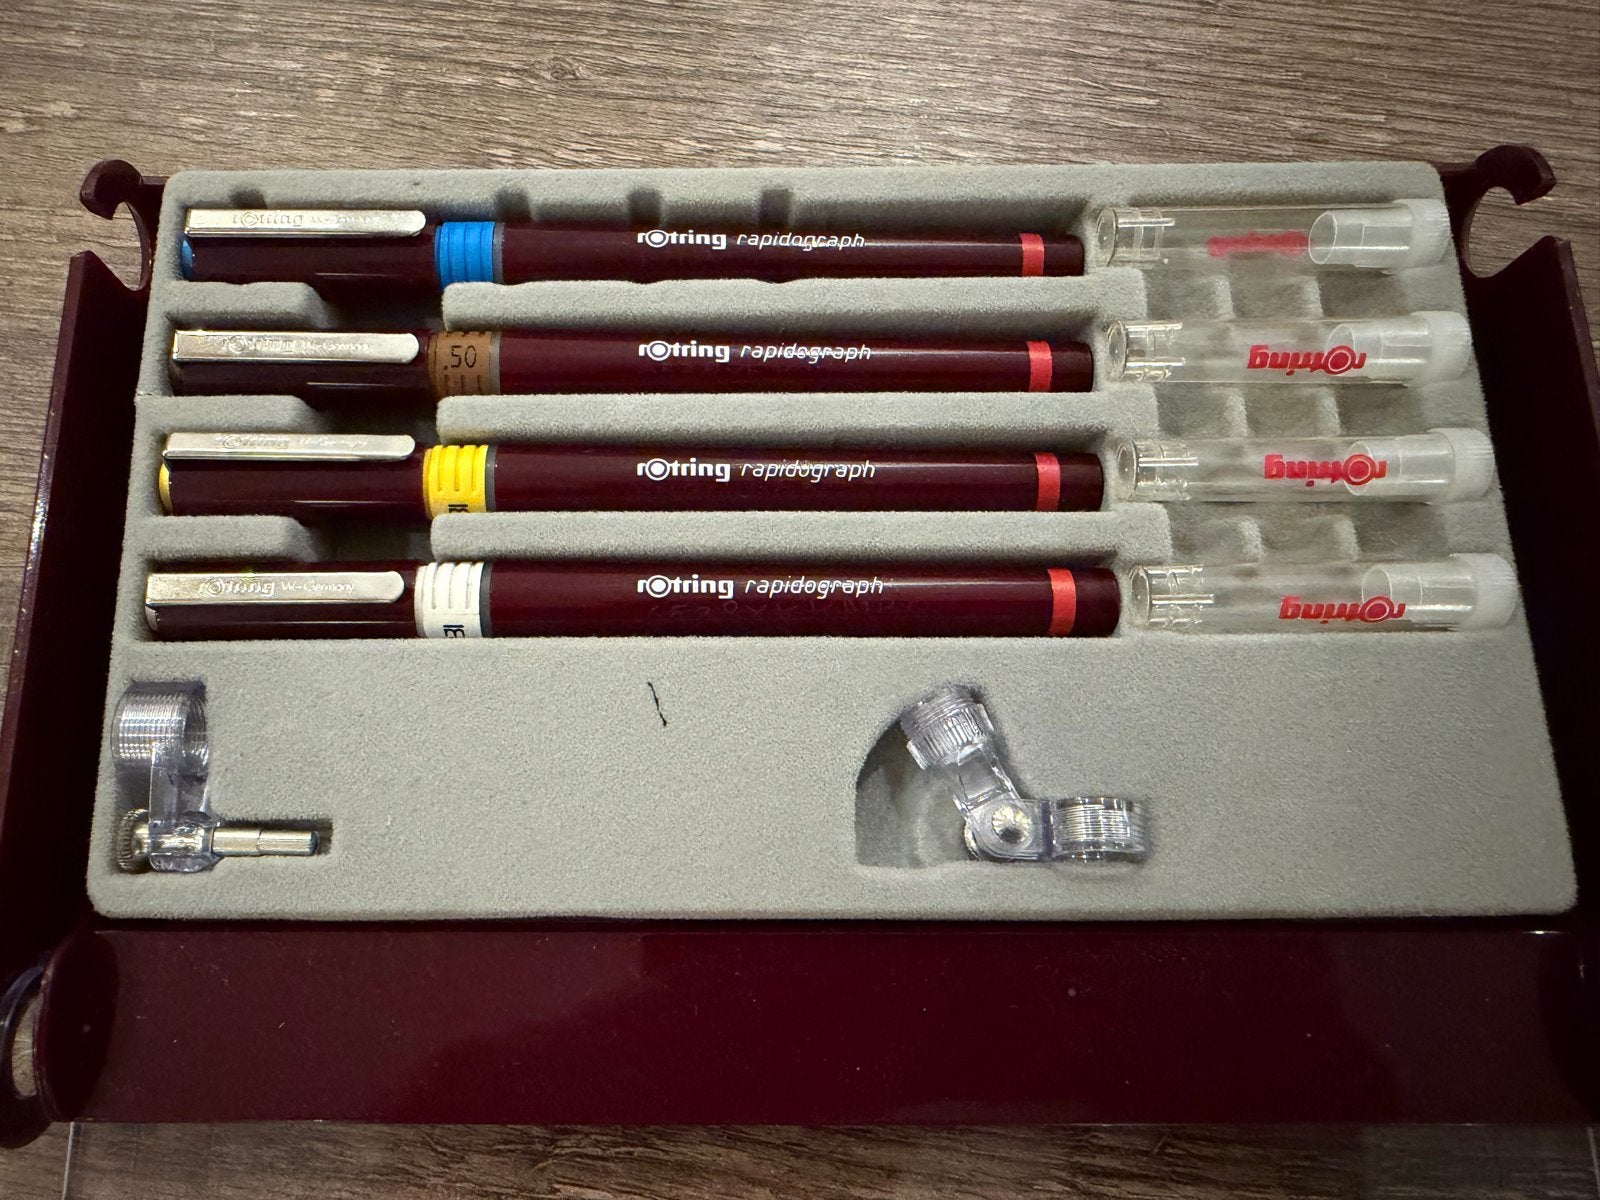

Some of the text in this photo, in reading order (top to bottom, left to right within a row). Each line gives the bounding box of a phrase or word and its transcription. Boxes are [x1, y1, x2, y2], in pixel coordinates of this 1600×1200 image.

[637, 229, 865, 251] rotring rapidograph
[443, 344, 478, 372] .50
[638, 340, 871, 364] rotring rapidograph
[1246, 344, 1367, 376] rotring
[637, 457, 876, 483] rotring rapidograph
[1263, 453, 1388, 487] rotring
[637, 573, 884, 600] rotring rapidograph
[1279, 594, 1406, 624] rotring
